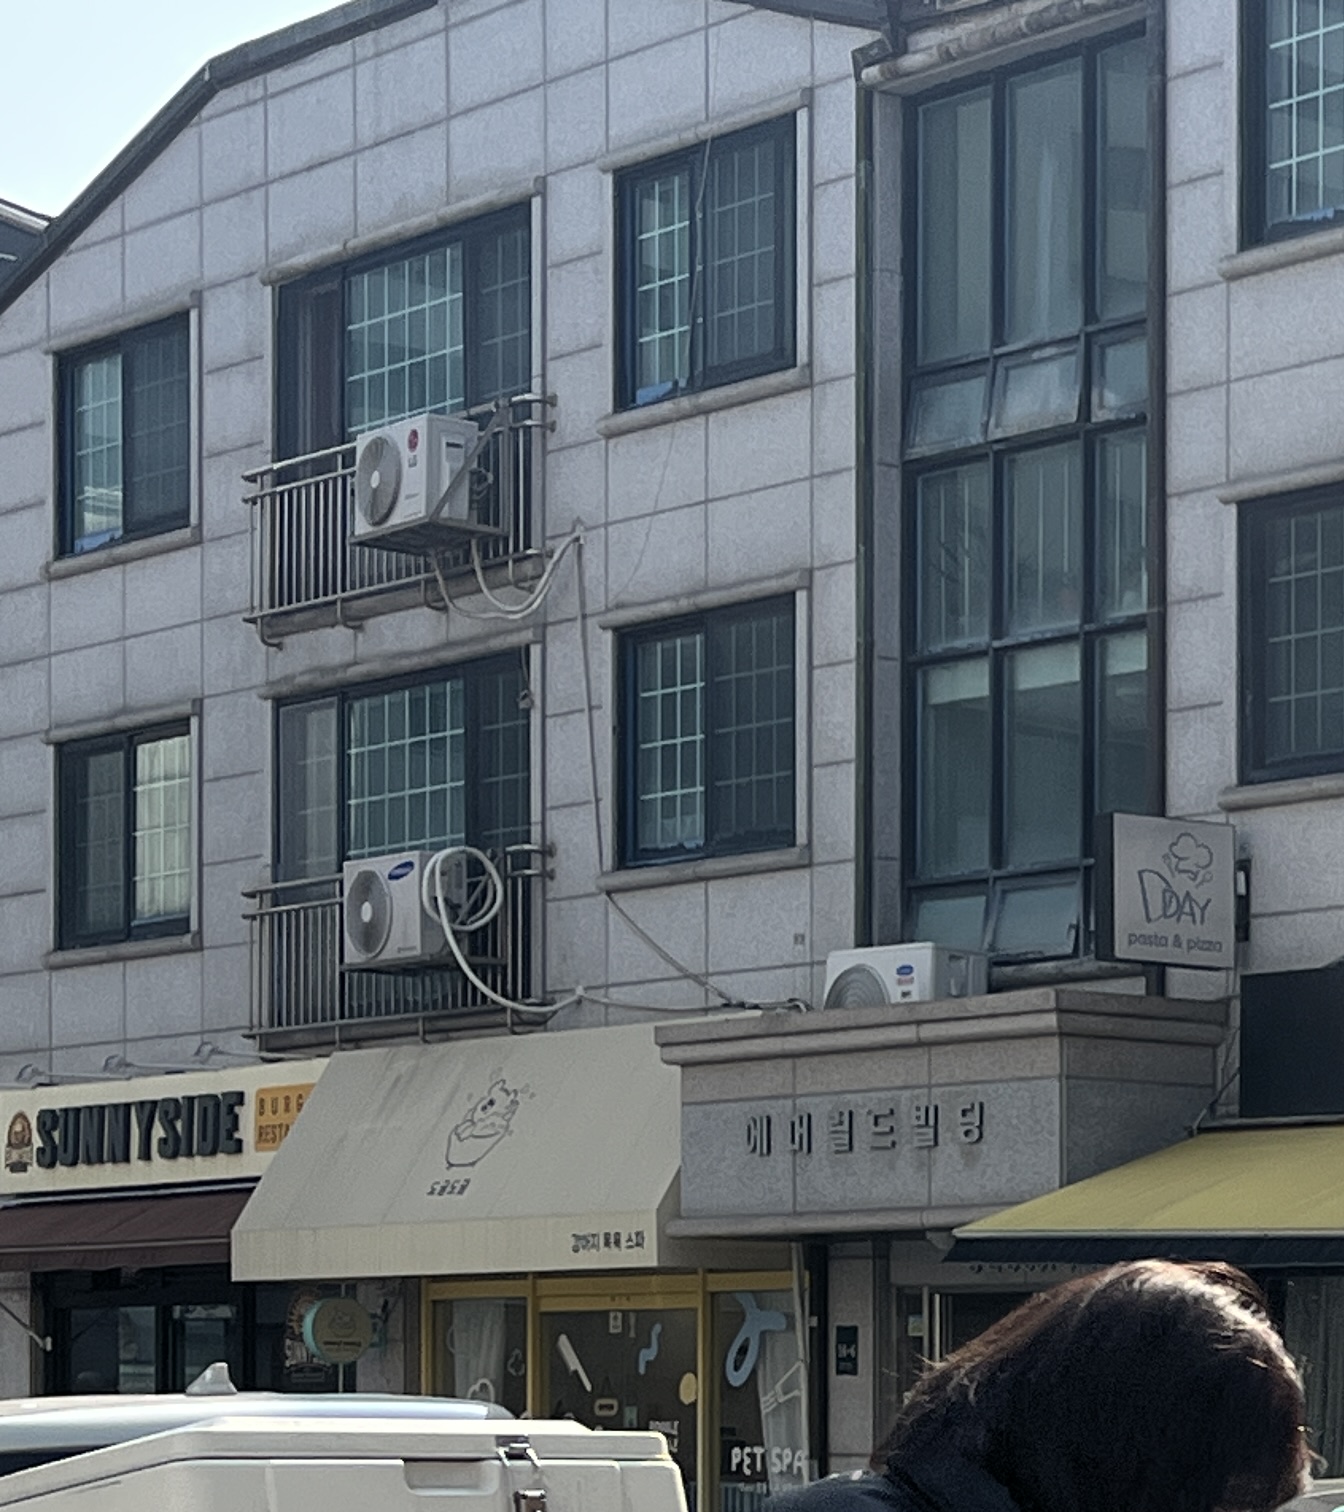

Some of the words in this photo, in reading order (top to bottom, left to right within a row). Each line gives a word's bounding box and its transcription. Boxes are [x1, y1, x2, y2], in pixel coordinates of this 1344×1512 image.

[1127, 932, 1169, 948] pasta
[1172, 933, 1183, 949] &
[36, 1090, 245, 1170] SUNNYSIDE
[731, 1446, 765, 1475] PET
